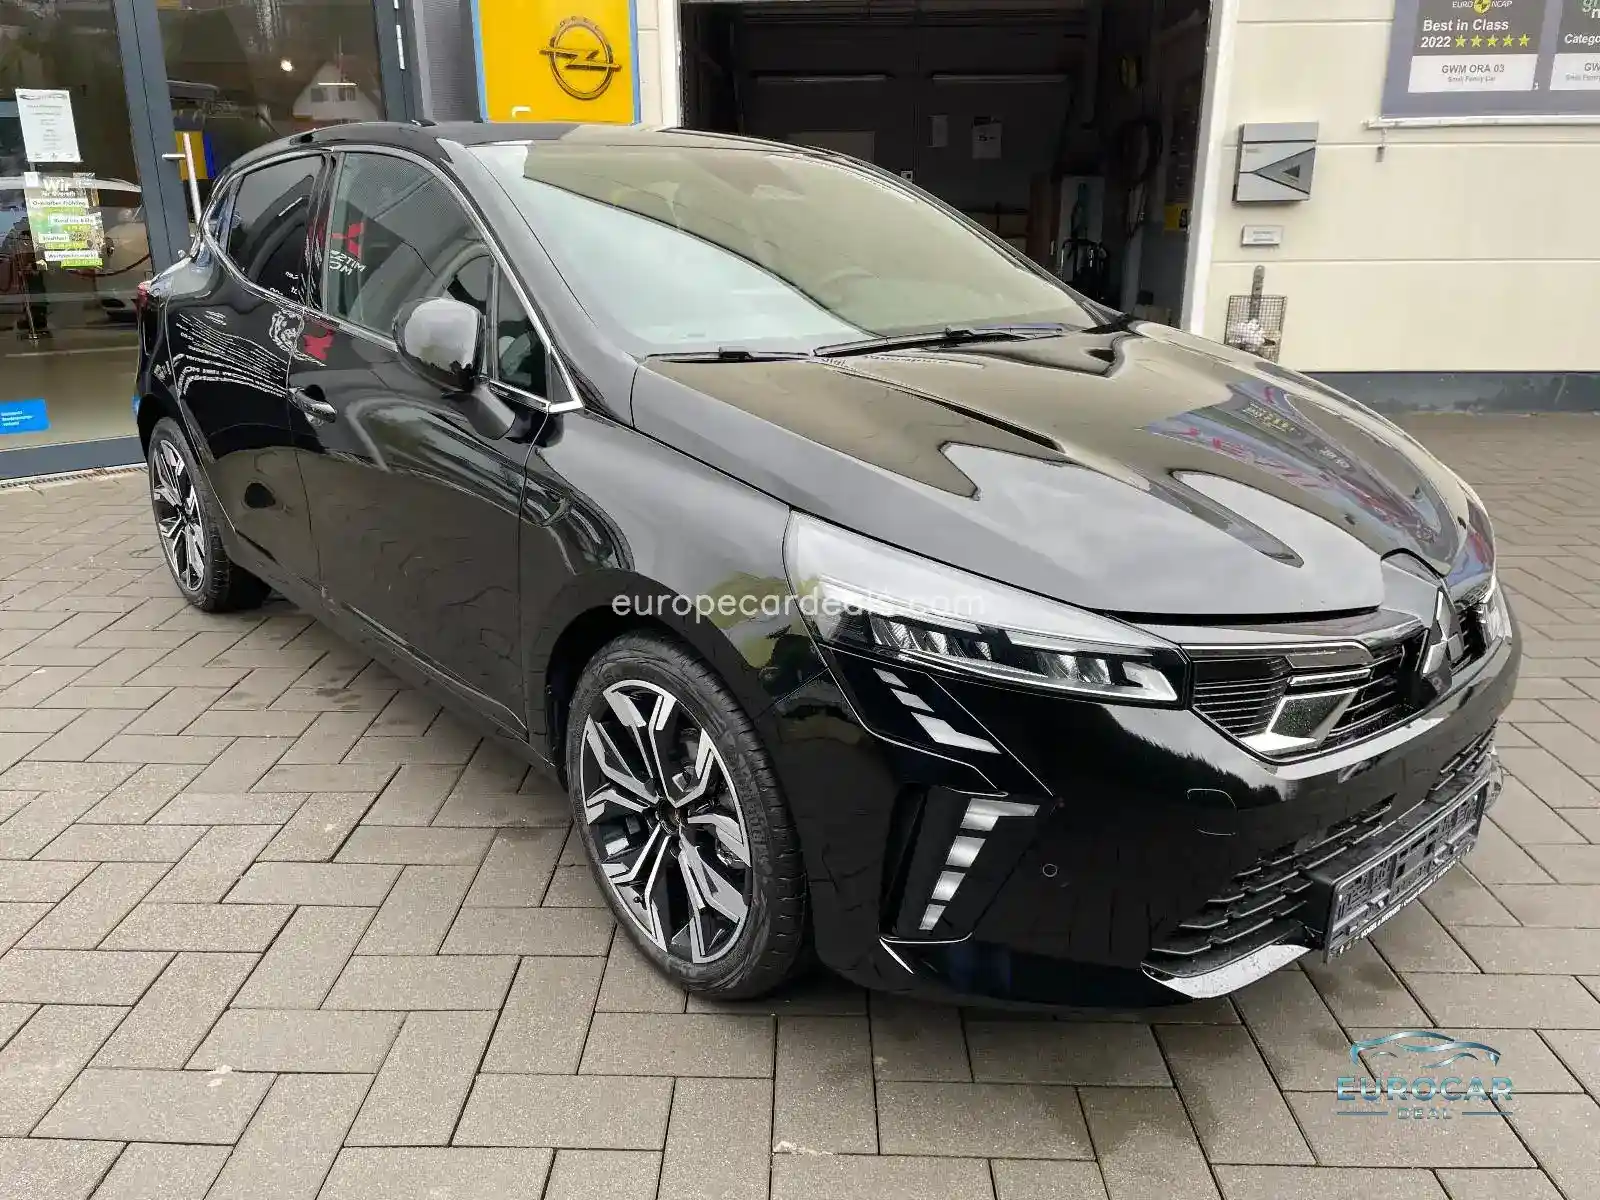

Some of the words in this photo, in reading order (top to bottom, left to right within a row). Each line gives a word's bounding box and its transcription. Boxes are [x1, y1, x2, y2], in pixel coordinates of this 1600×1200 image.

[1491, 0, 1513, 8] NCAP
[1423, 19, 1454, 32] Best
[1456, 19, 1469, 31] in
[1472, 18, 1509, 31] Class
[1420, 36, 1451, 48] 2022
[1441, 64, 1467, 74] GWM
[1469, 64, 1491, 73] ORA
[1493, 63, 1505, 73] 03
